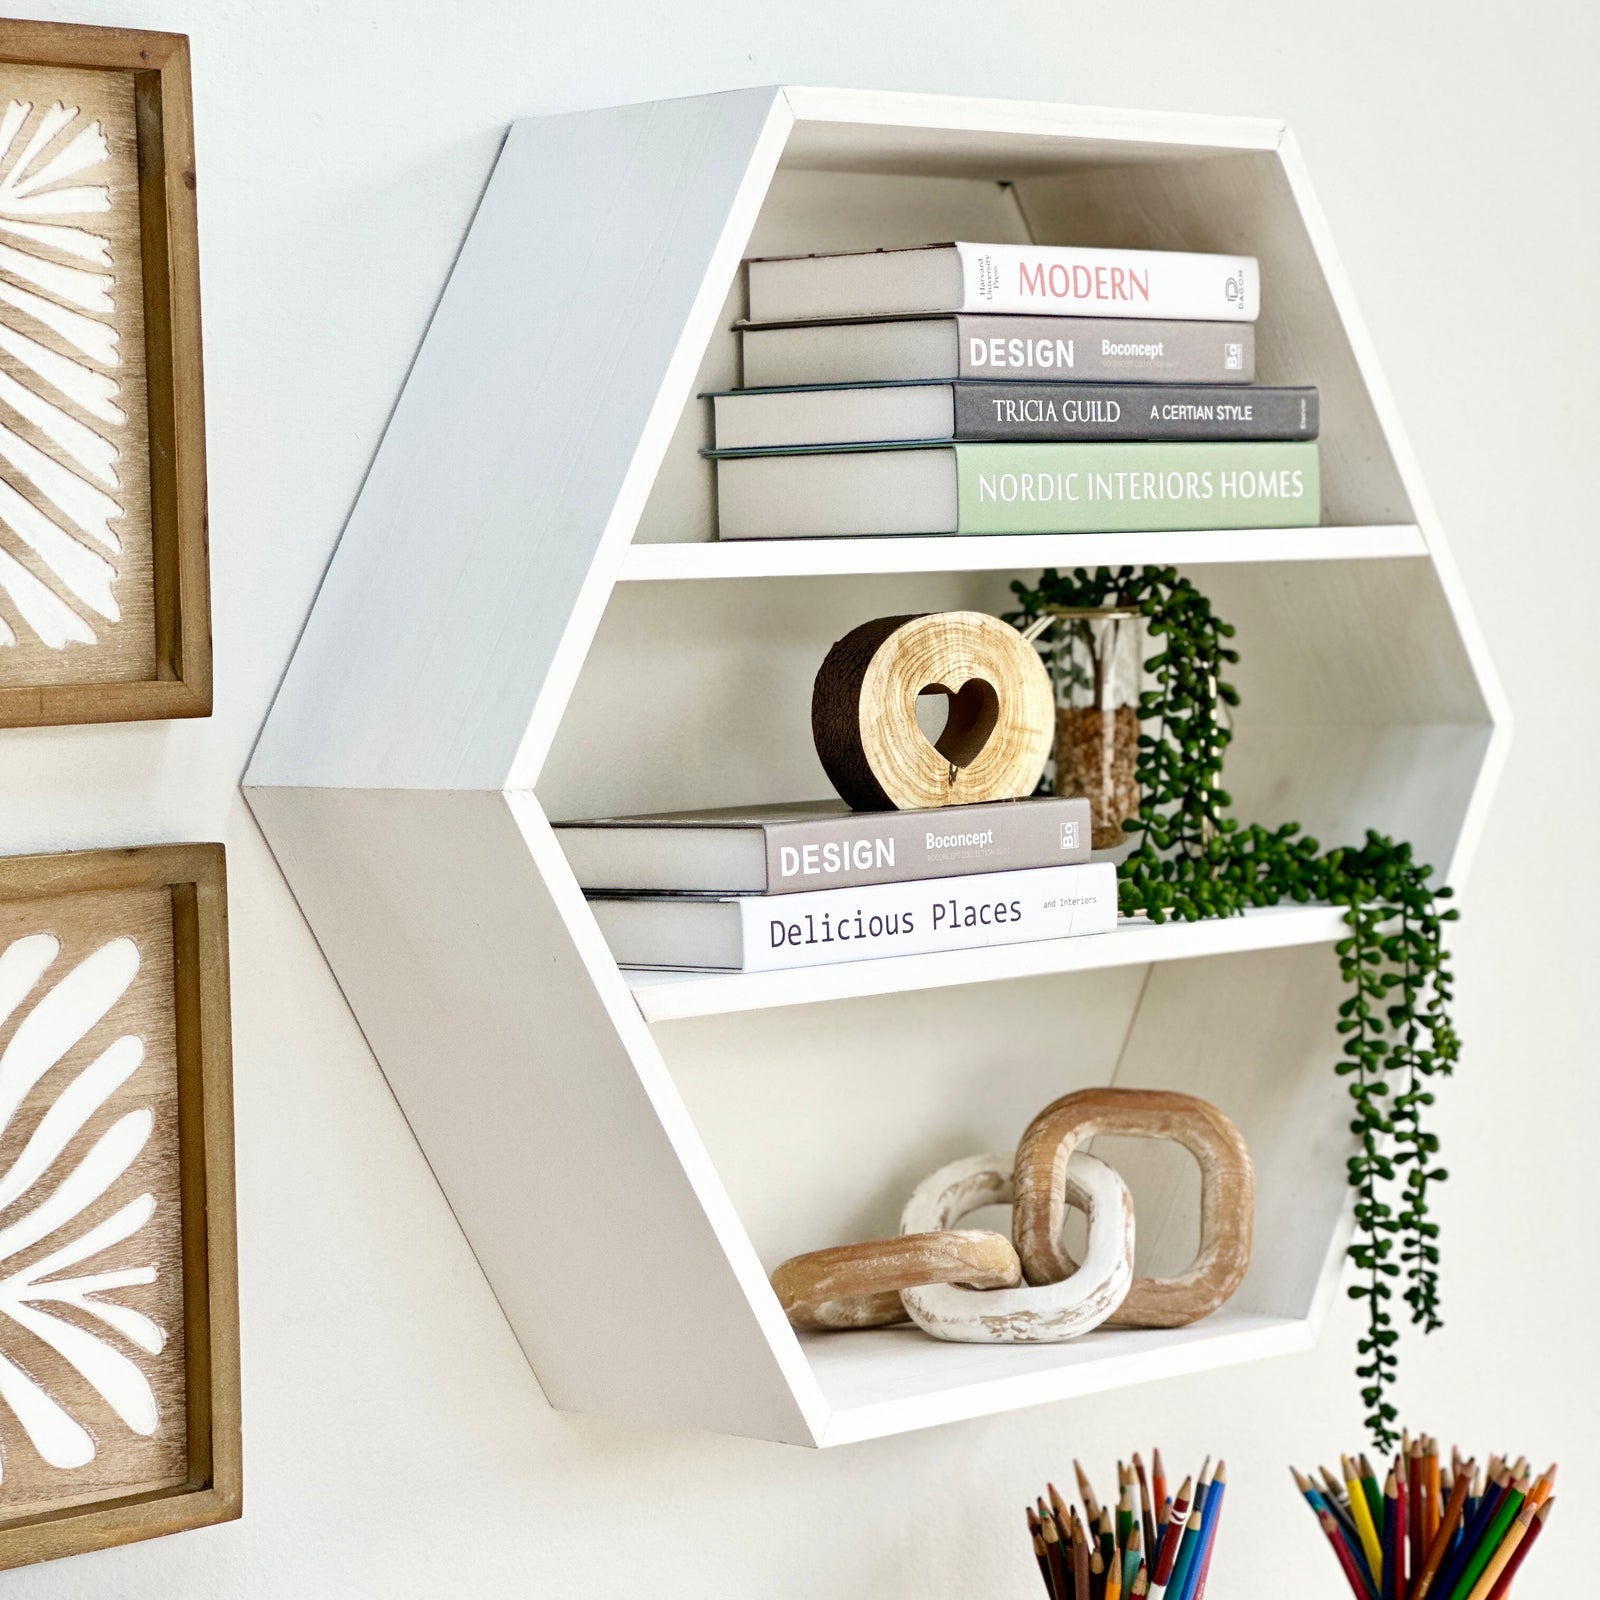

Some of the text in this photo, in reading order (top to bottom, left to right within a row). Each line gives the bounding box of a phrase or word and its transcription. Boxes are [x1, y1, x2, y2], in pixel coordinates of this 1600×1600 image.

[1019, 262, 1150, 302] MODERN
[969, 337, 1075, 368] DESIGN
[1101, 340, 1164, 359] Boconcept
[992, 399, 1121, 423] TRICIA GUILD
[1150, 404, 1253, 421] A CERTIAN STYLE
[978, 470, 1304, 502] NORDIC INTERIORS HOMES
[926, 829, 993, 850] Boconcept
[780, 837, 896, 877] DESIGN
[1043, 896, 1097, 909] and Interiors
[770, 899, 1022, 948] Delicious Places
